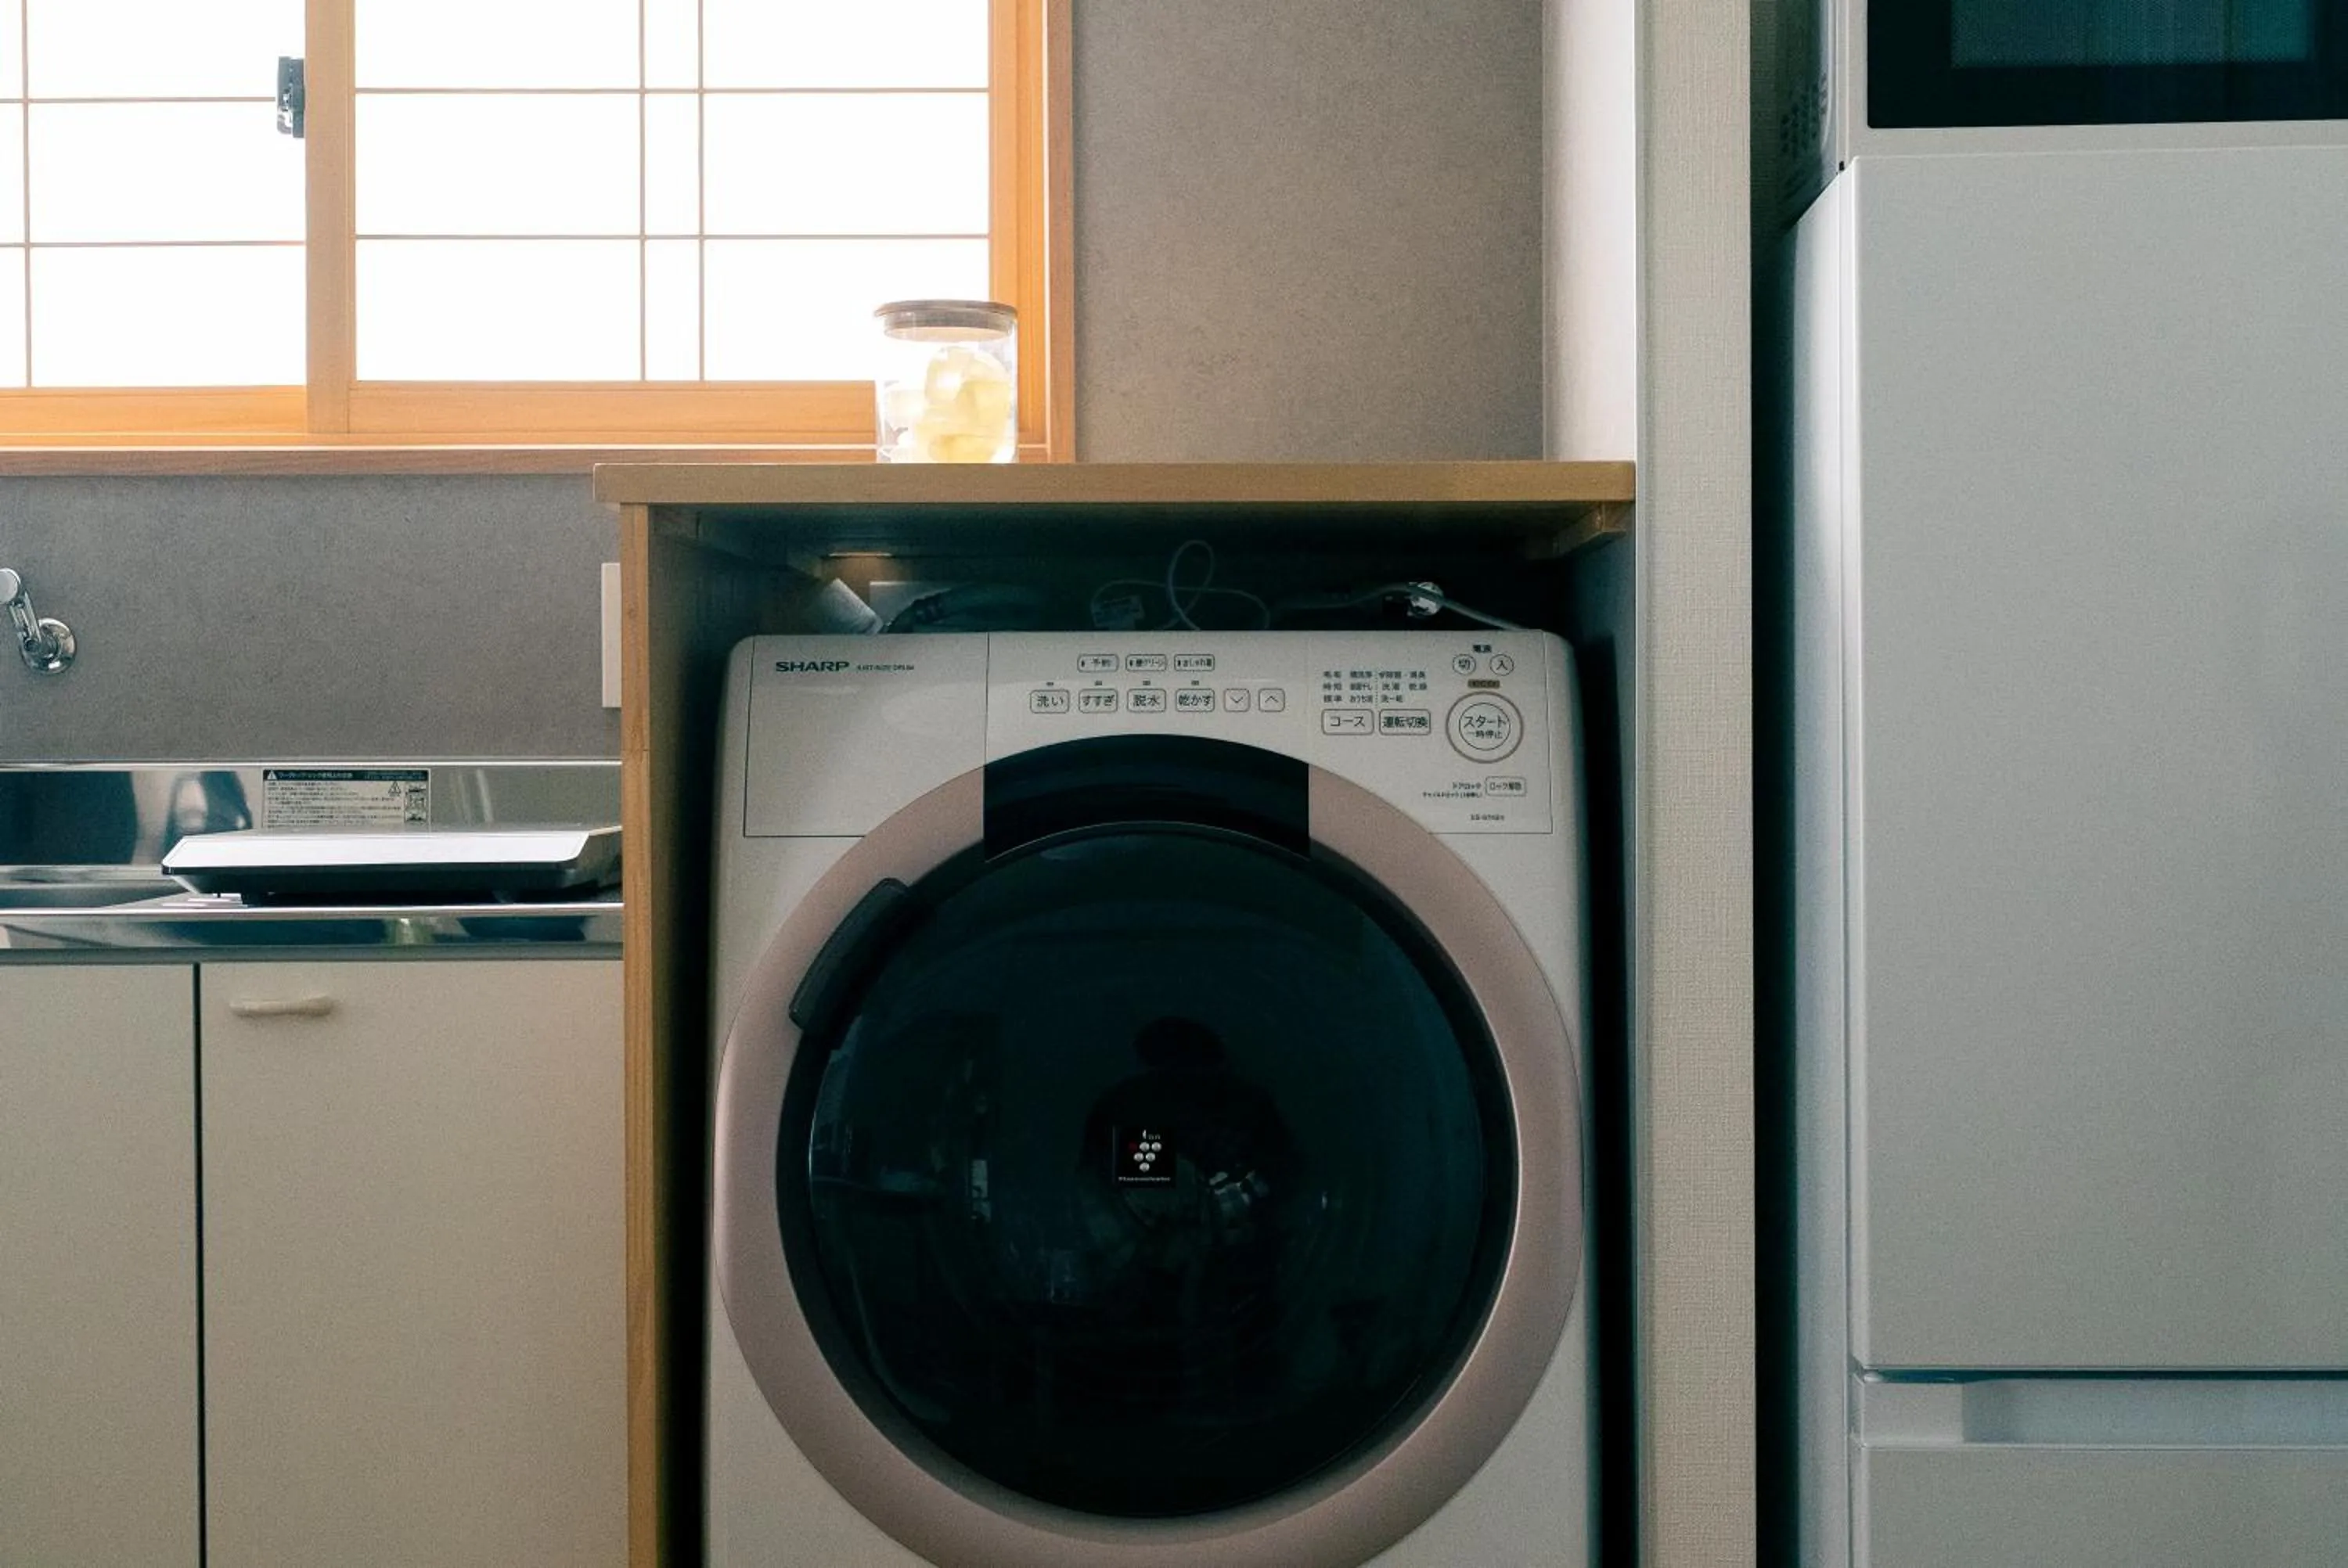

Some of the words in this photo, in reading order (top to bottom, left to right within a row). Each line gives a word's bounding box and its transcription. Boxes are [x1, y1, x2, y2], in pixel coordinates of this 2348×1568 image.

[776, 661, 850, 672] SHARP
[1496, 660, 1508, 671] 入
[1037, 696, 1064, 707] 洗い
[1082, 695, 1115, 707] すすぎ
[1133, 694, 1161, 707] 脱水
[1179, 694, 1212, 707] 乾かす
[1330, 716, 1366, 727] コース
[1382, 716, 1428, 728] 運転切換
[1464, 714, 1507, 728] スタート
